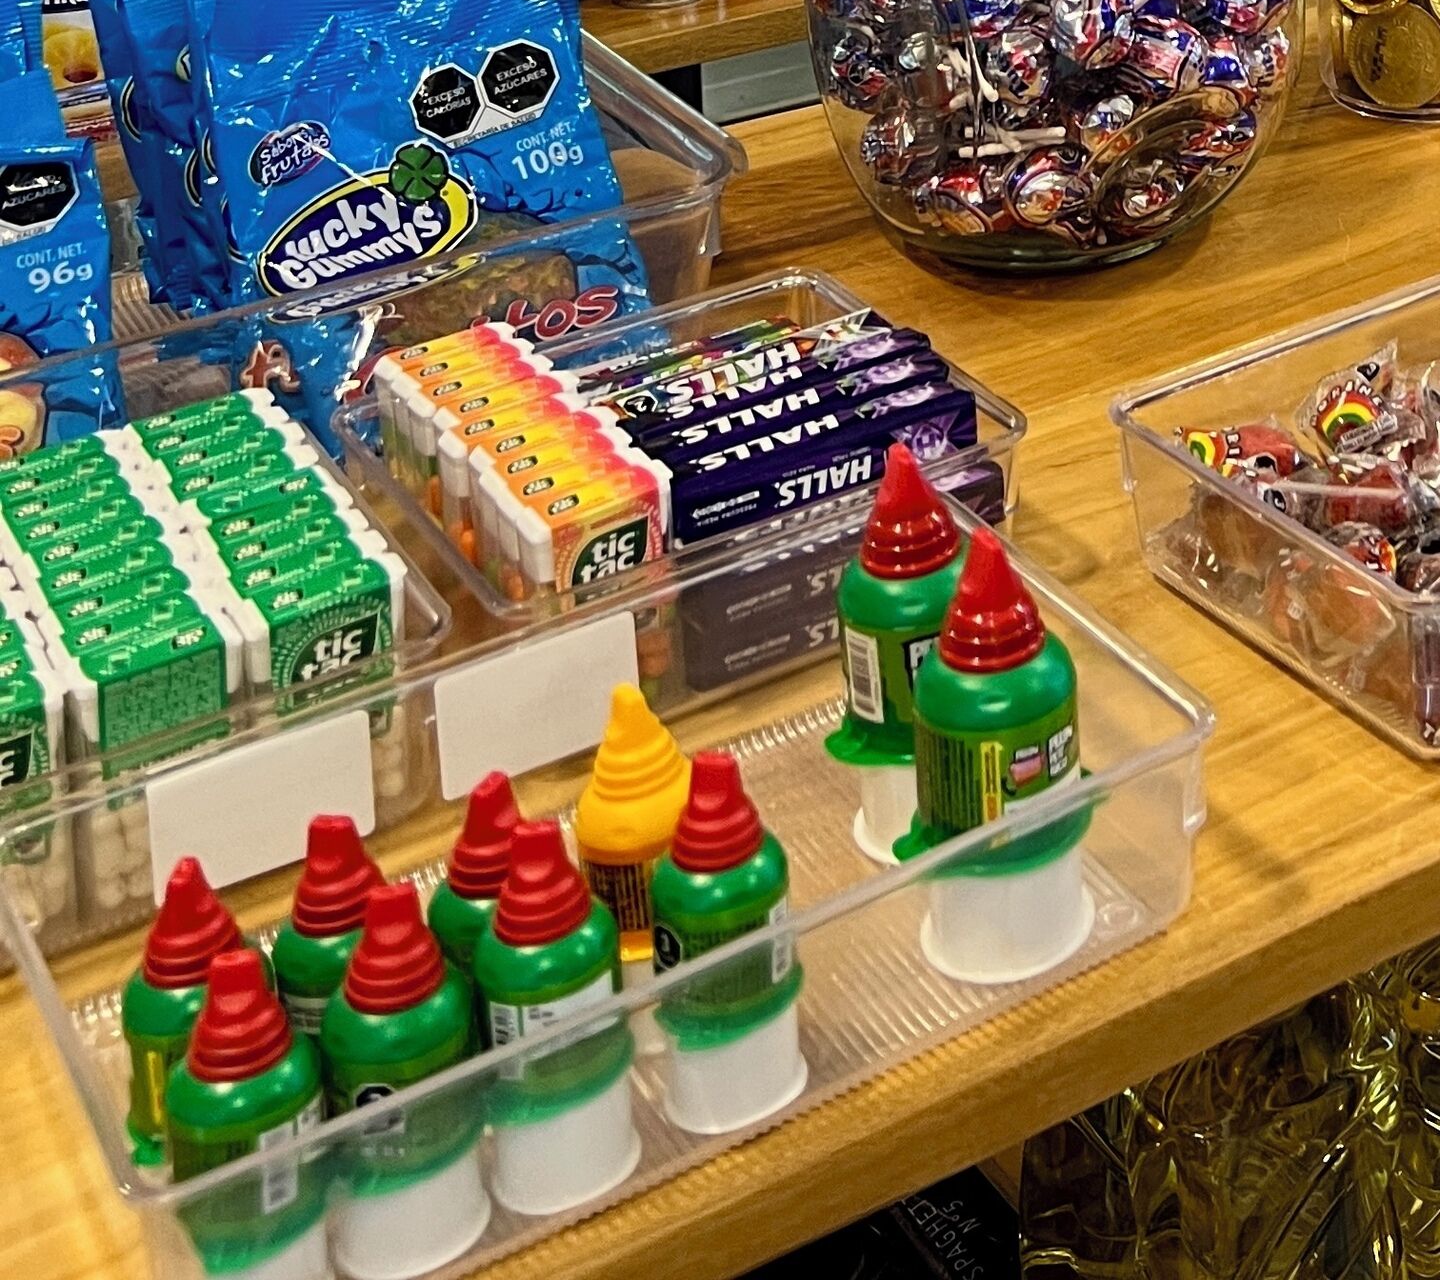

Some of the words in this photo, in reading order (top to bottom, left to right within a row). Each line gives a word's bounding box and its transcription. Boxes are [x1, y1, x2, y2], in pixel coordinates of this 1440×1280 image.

[496, 61, 537, 82] EXCESO
[427, 87, 466, 107] EXCESO
[516, 132, 548, 152] CONT.
[549, 121, 576, 140] NET.
[512, 141, 584, 180] 100g
[16, 249, 56, 268] CONT.
[59, 242, 87, 260] NET.
[278, 205, 442, 290] Gummys
[28, 261, 94, 294] 96g
[667, 341, 801, 404] HALLS
[680, 388, 821, 444] HALLS
[697, 414, 840, 472] HALLS
[778, 454, 873, 508] HALLS
[591, 531, 636, 564] tic
[580, 550, 635, 584] tac
[314, 624, 364, 665] tic
